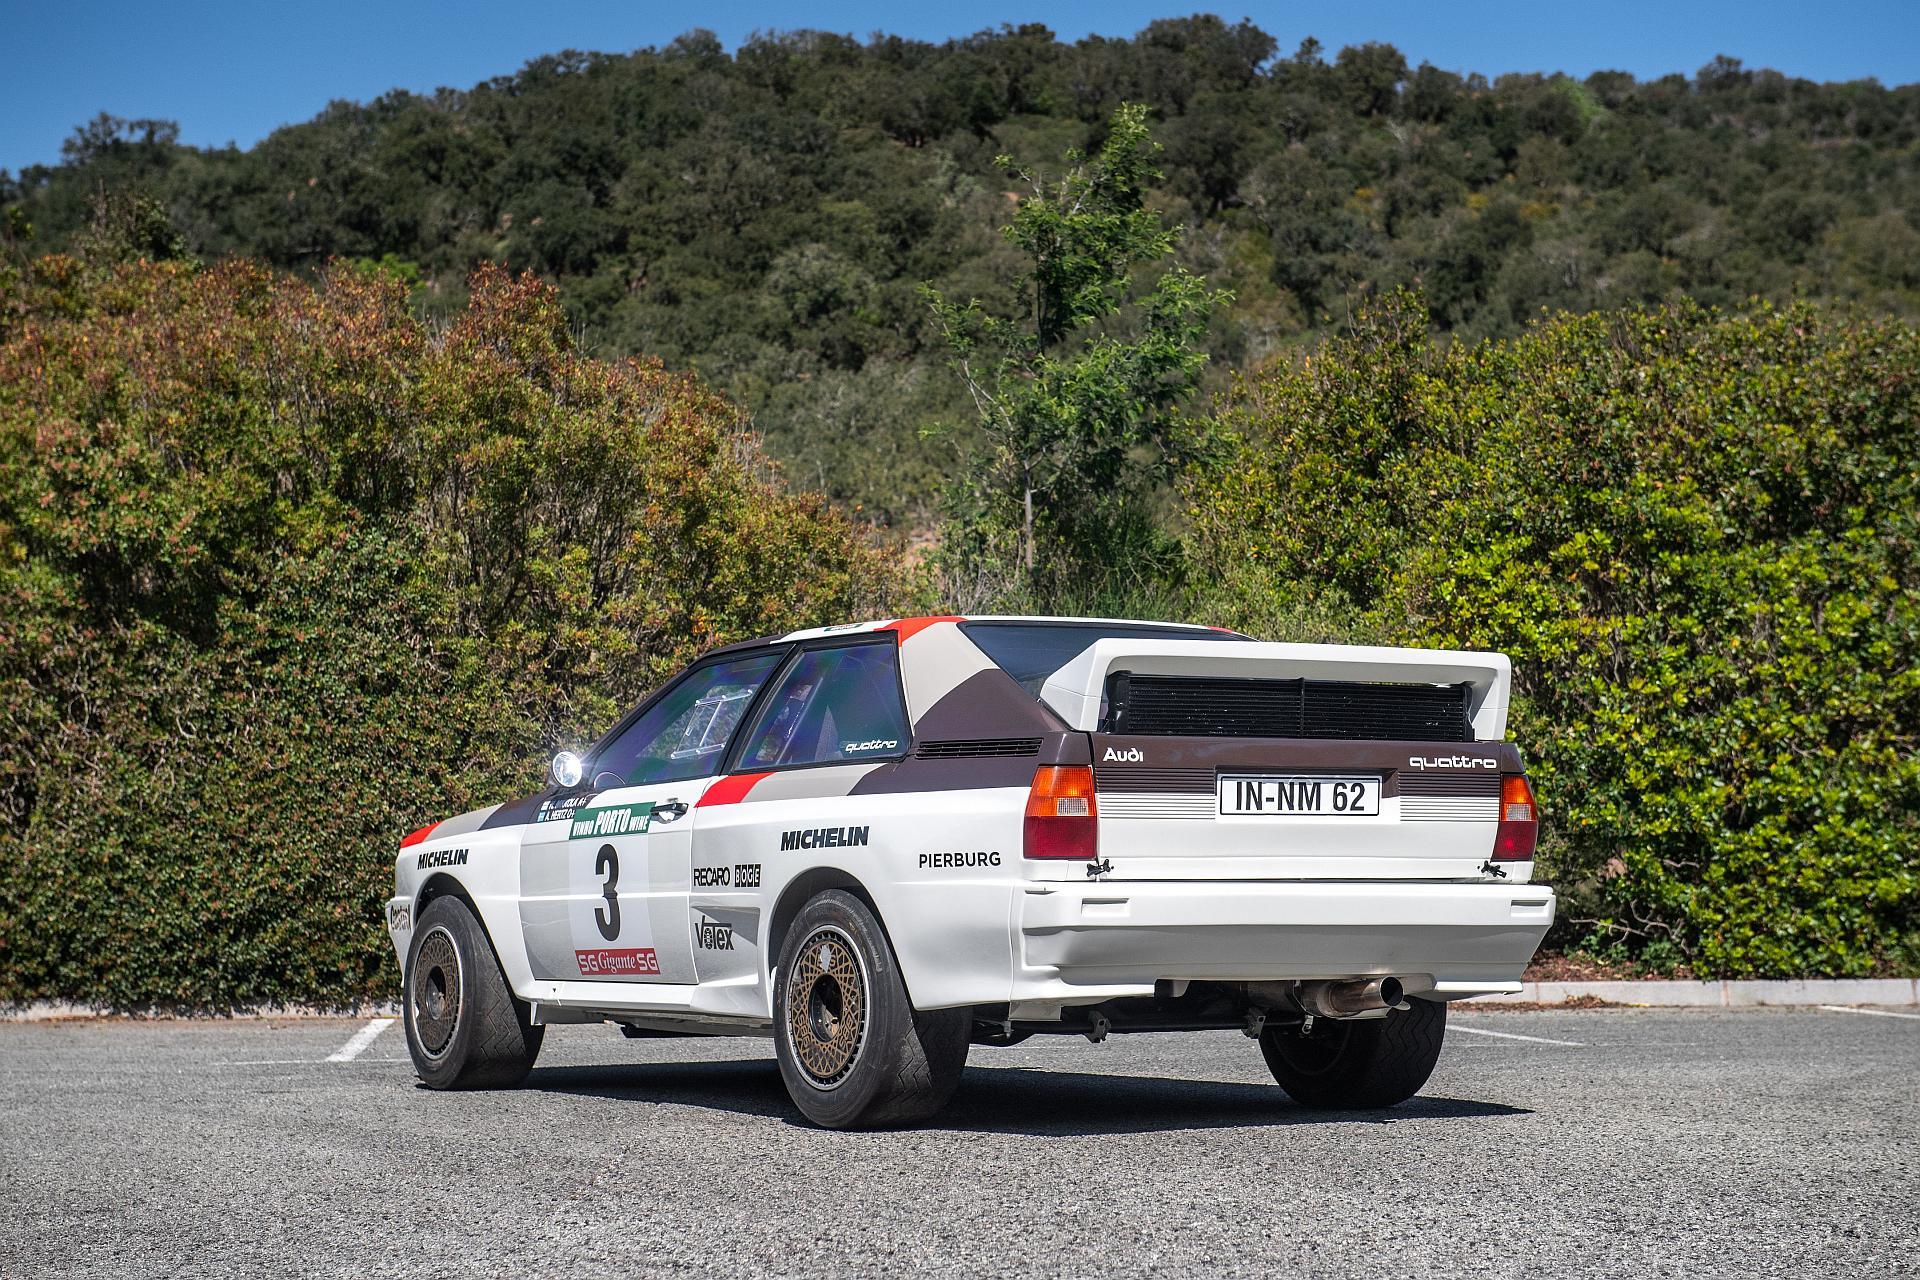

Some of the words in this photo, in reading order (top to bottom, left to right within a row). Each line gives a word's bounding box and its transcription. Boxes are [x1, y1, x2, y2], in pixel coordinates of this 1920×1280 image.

[845, 739, 898, 753] quattro
[1102, 746, 1145, 762] Audi
[1408, 755, 1498, 771] quattro
[1235, 780, 1322, 812] IN-NM
[1331, 781, 1366, 812] 62
[573, 821, 594, 836] VINHO
[594, 808, 631, 834] PORTO
[629, 815, 649, 831] WINE
[780, 825, 870, 851] MICHELIN
[417, 849, 469, 870] MICHELIN
[918, 851, 1001, 869] PIERBURG
[693, 867, 731, 887] RECARO
[735, 865, 761, 886] BOGE
[594, 843, 621, 942] 3
[578, 954, 599, 971] SG
[598, 952, 636, 973] Gigante
[636, 953, 659, 970] SG
